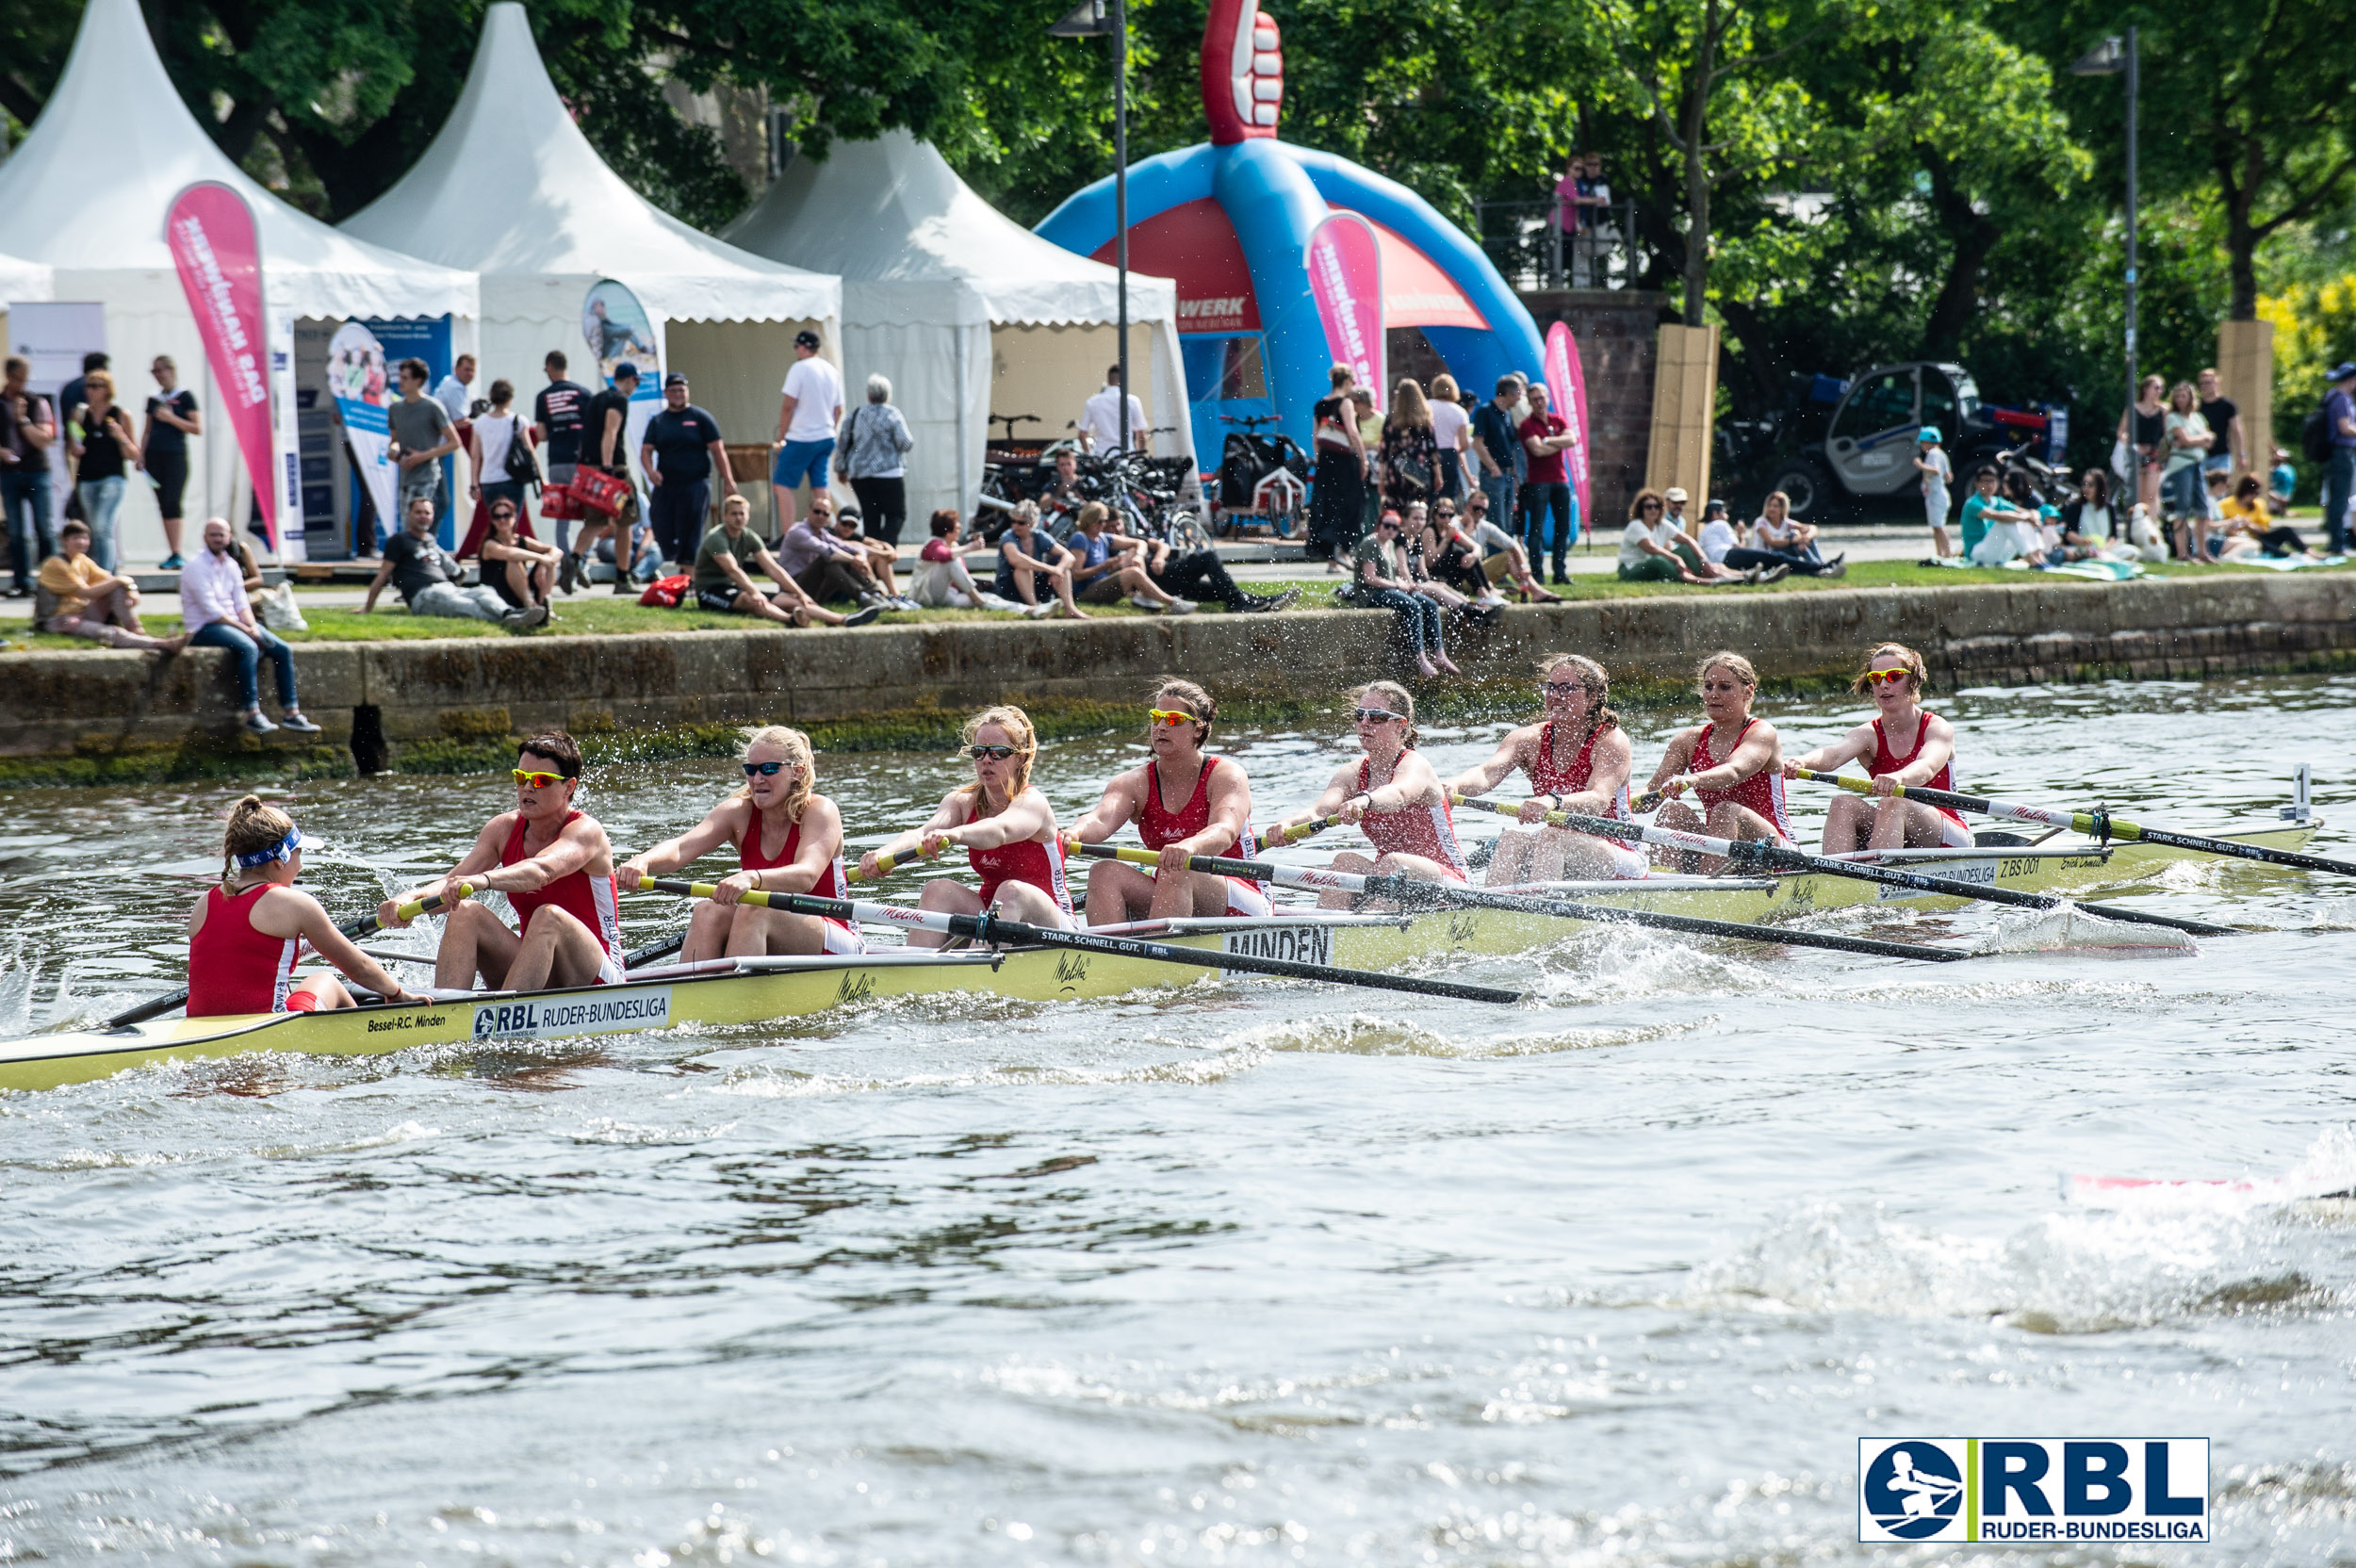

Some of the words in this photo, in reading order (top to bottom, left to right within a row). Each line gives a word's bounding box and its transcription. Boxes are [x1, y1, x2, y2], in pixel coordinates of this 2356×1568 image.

[1176, 296, 1246, 318] WERK
[2297, 768, 2304, 803] 1
[1669, 831, 1708, 847] Melitta
[2148, 831, 2175, 843] STARK.
[2176, 837, 2215, 849] SCHNELL.
[2217, 843, 2236, 854] GUT.
[249, 854, 262, 865] NK
[1813, 857, 1841, 870] STARK.
[1843, 863, 1882, 877] SCHNELL.
[2000, 860, 2009, 878] Z
[2009, 859, 2022, 877] BS
[2023, 858, 2040, 874] 001
[2061, 857, 2079, 870] Erich
[1296, 870, 1342, 889] Melitta
[875, 906, 927, 924] Melitta
[628, 951, 646, 964] STARK.
[645, 941, 669, 956] SCHNELL.
[667, 937, 680, 948] GUT.
[1041, 931, 1073, 943] STARK.
[1074, 936, 1118, 950] SCHNELL.
[1119, 941, 1140, 953] GUT.
[1152, 945, 1169, 956] RBL
[1228, 925, 1329, 976] MINDEN
[496, 1004, 538, 1032] RBL
[543, 997, 666, 1028] RUDER-BUNDESLIGA
[368, 1015, 413, 1034] Bessel-R.C.
[415, 1014, 446, 1029] Minden
